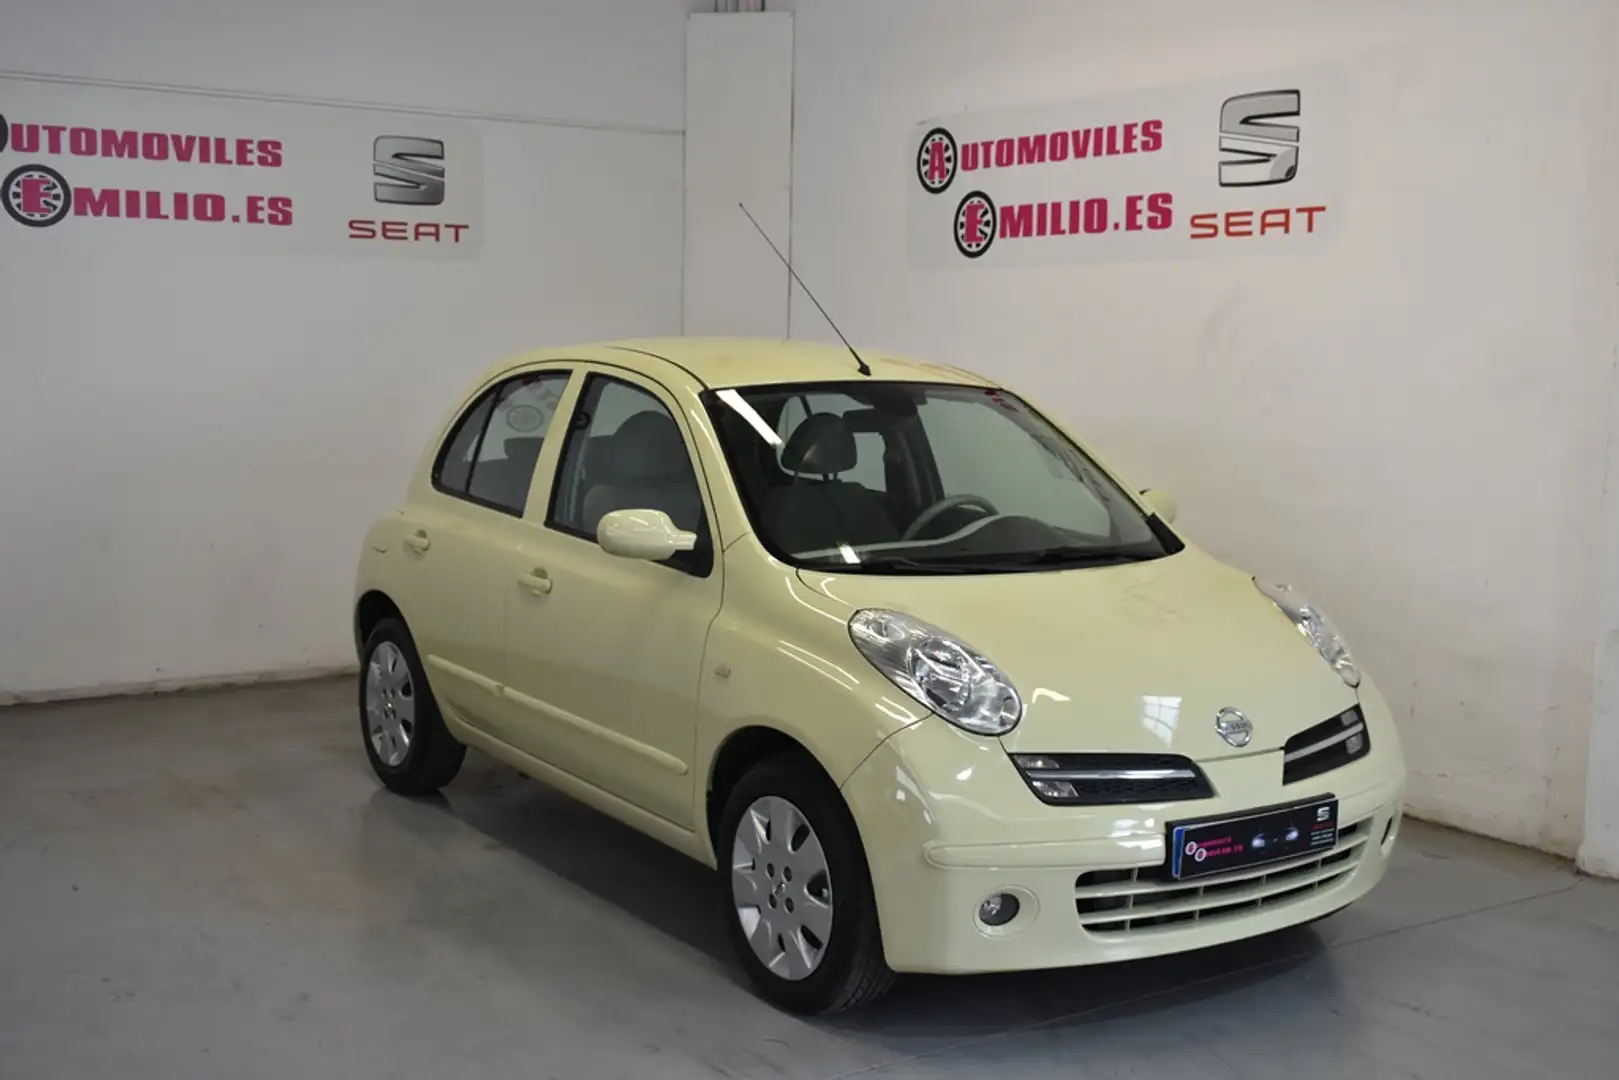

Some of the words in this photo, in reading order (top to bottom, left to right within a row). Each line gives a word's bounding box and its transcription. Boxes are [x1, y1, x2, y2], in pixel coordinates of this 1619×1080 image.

[9, 122, 284, 168] UTOMOVILES
[928, 119, 1163, 181] AUTOMOVILES
[21, 177, 294, 227] EMILIO.ES
[964, 192, 1173, 244] EMILIO.ES
[1189, 206, 1327, 240] SEAT
[347, 219, 470, 242] SEAT
